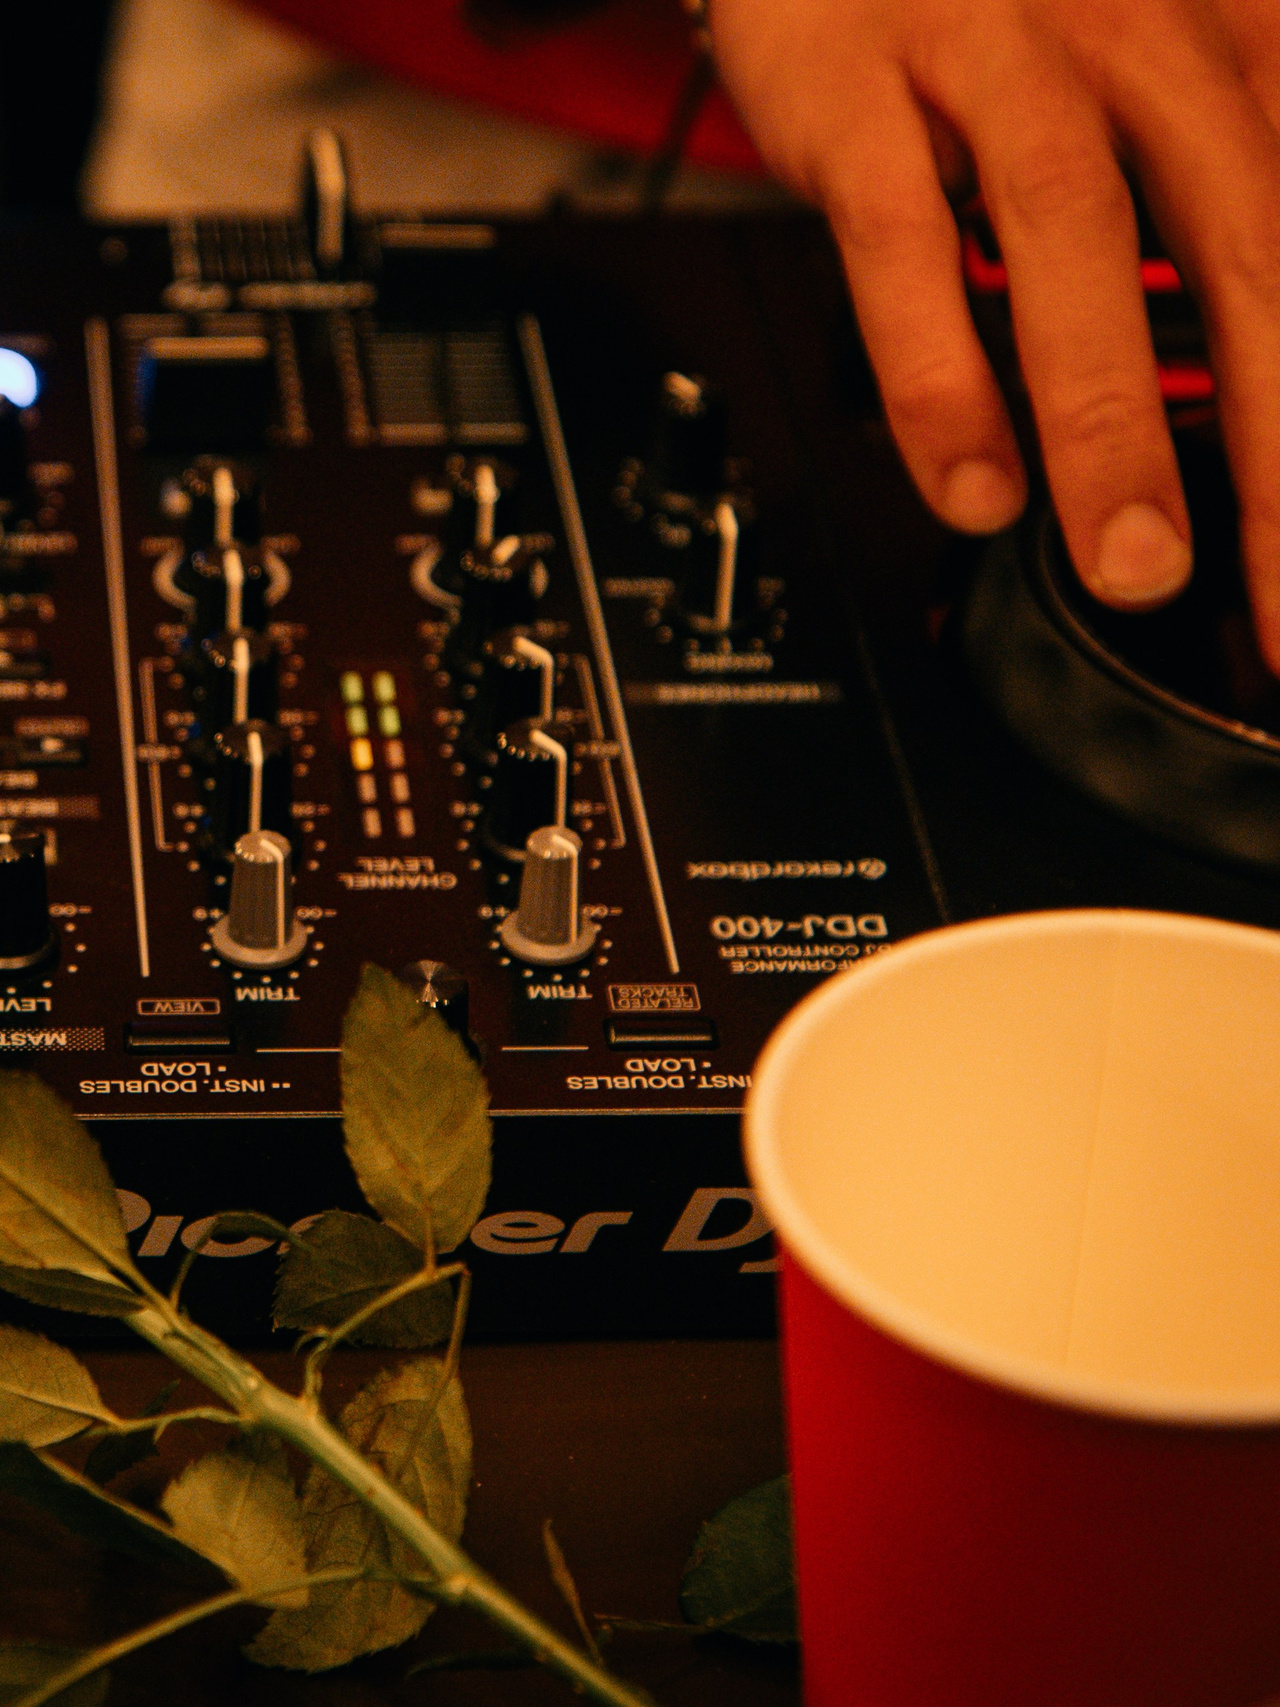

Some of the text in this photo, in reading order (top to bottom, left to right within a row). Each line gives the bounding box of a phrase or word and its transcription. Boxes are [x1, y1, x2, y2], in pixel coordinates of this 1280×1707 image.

[356, 856, 435, 872] LEVEL
[687, 860, 855, 882] rekordbox
[337, 872, 457, 890] CHANNEL
[710, 914, 888, 940] DDJ-400
[720, 944, 860, 959] CONTROLLER
[731, 958, 854, 975] FORMANCE
[235, 986, 300, 1001] TRIM
[527, 984, 592, 999] TRIM
[619, 986, 689, 998] TRACKS
[154, 1001, 204, 1013] VIEW
[618, 998, 694, 1010] RELATED
[141, 1062, 210, 1076] LOAD
[625, 1058, 696, 1072] LOAD
[79, 1079, 266, 1094] INST. DOUBLES
[566, 1075, 684, 1090] DOUBLES
